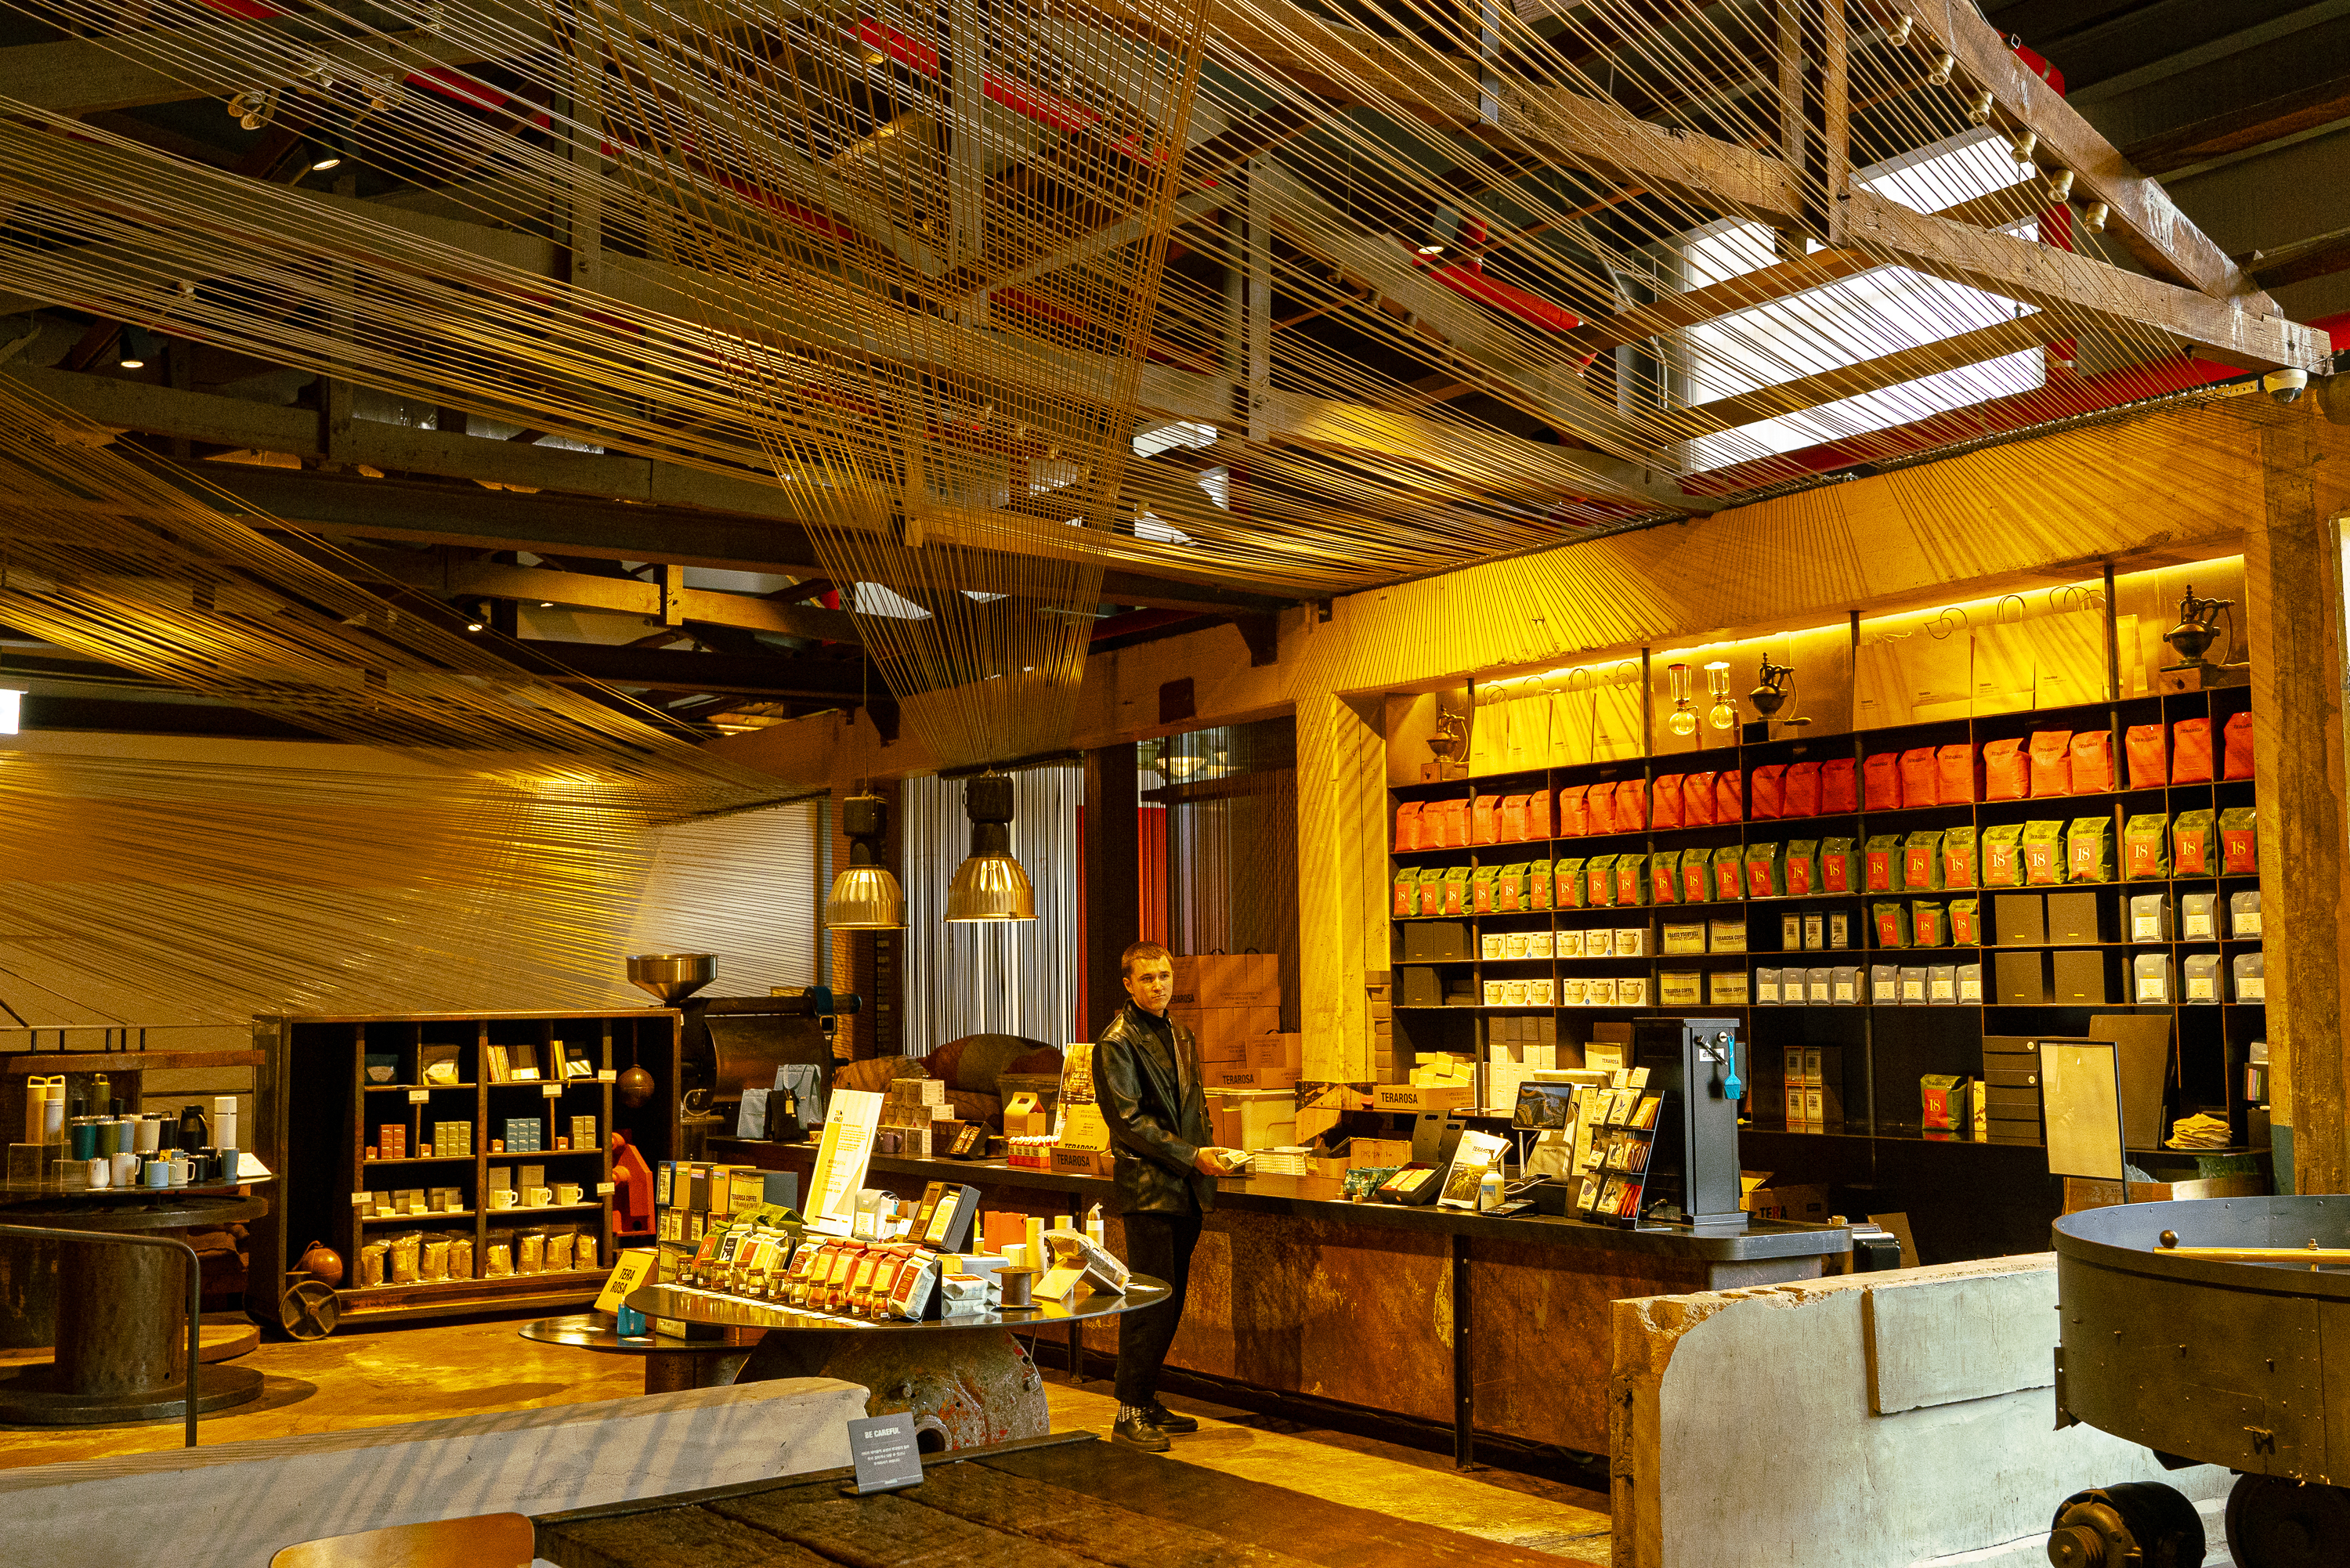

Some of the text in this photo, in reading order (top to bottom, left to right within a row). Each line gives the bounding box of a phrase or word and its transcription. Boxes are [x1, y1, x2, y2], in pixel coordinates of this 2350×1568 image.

[2134, 844, 2148, 858] 18
[2182, 841, 2196, 855] 18
[2231, 840, 2246, 855] 18
[2032, 853, 2045, 867] 18
[2077, 847, 2090, 862] 18
[1912, 858, 1923, 870] 18
[1951, 858, 1963, 871] 18
[1992, 854, 2005, 867] 18
[1793, 866, 1803, 878] 18
[1828, 864, 1839, 876] 18
[1872, 862, 1882, 873] 18
[1689, 875, 1698, 887] 18
[1723, 872, 1733, 883] 18
[1755, 870, 1765, 882] 18
[1535, 883, 1542, 893] 18
[1593, 880, 1601, 891] 18
[1622, 879, 1630, 890] 18
[1658, 877, 1667, 888] 18
[1506, 886, 1513, 895] 18
[1561, 883, 1569, 894] 18
[1398, 891, 1405, 901] 18
[1424, 892, 1432, 901] 18
[1449, 891, 1456, 901] 18
[1478, 890, 1486, 899] 18
[1882, 923, 1893, 932] 18
[1921, 921, 1930, 930] 18
[1957, 919, 1966, 929] 18
[1223, 1074, 1254, 1085] TERAROSA
[1381, 1093, 1418, 1104] TERAROSA
[1929, 1099, 1940, 1111] 18
[1057, 1154, 1090, 1167] TERAROSA
[1759, 1206, 1787, 1219] TERA
[619, 1268, 635, 1281] TERA
[610, 1281, 627, 1295] ROSA
[874, 1427, 901, 1437] CAREFUL
